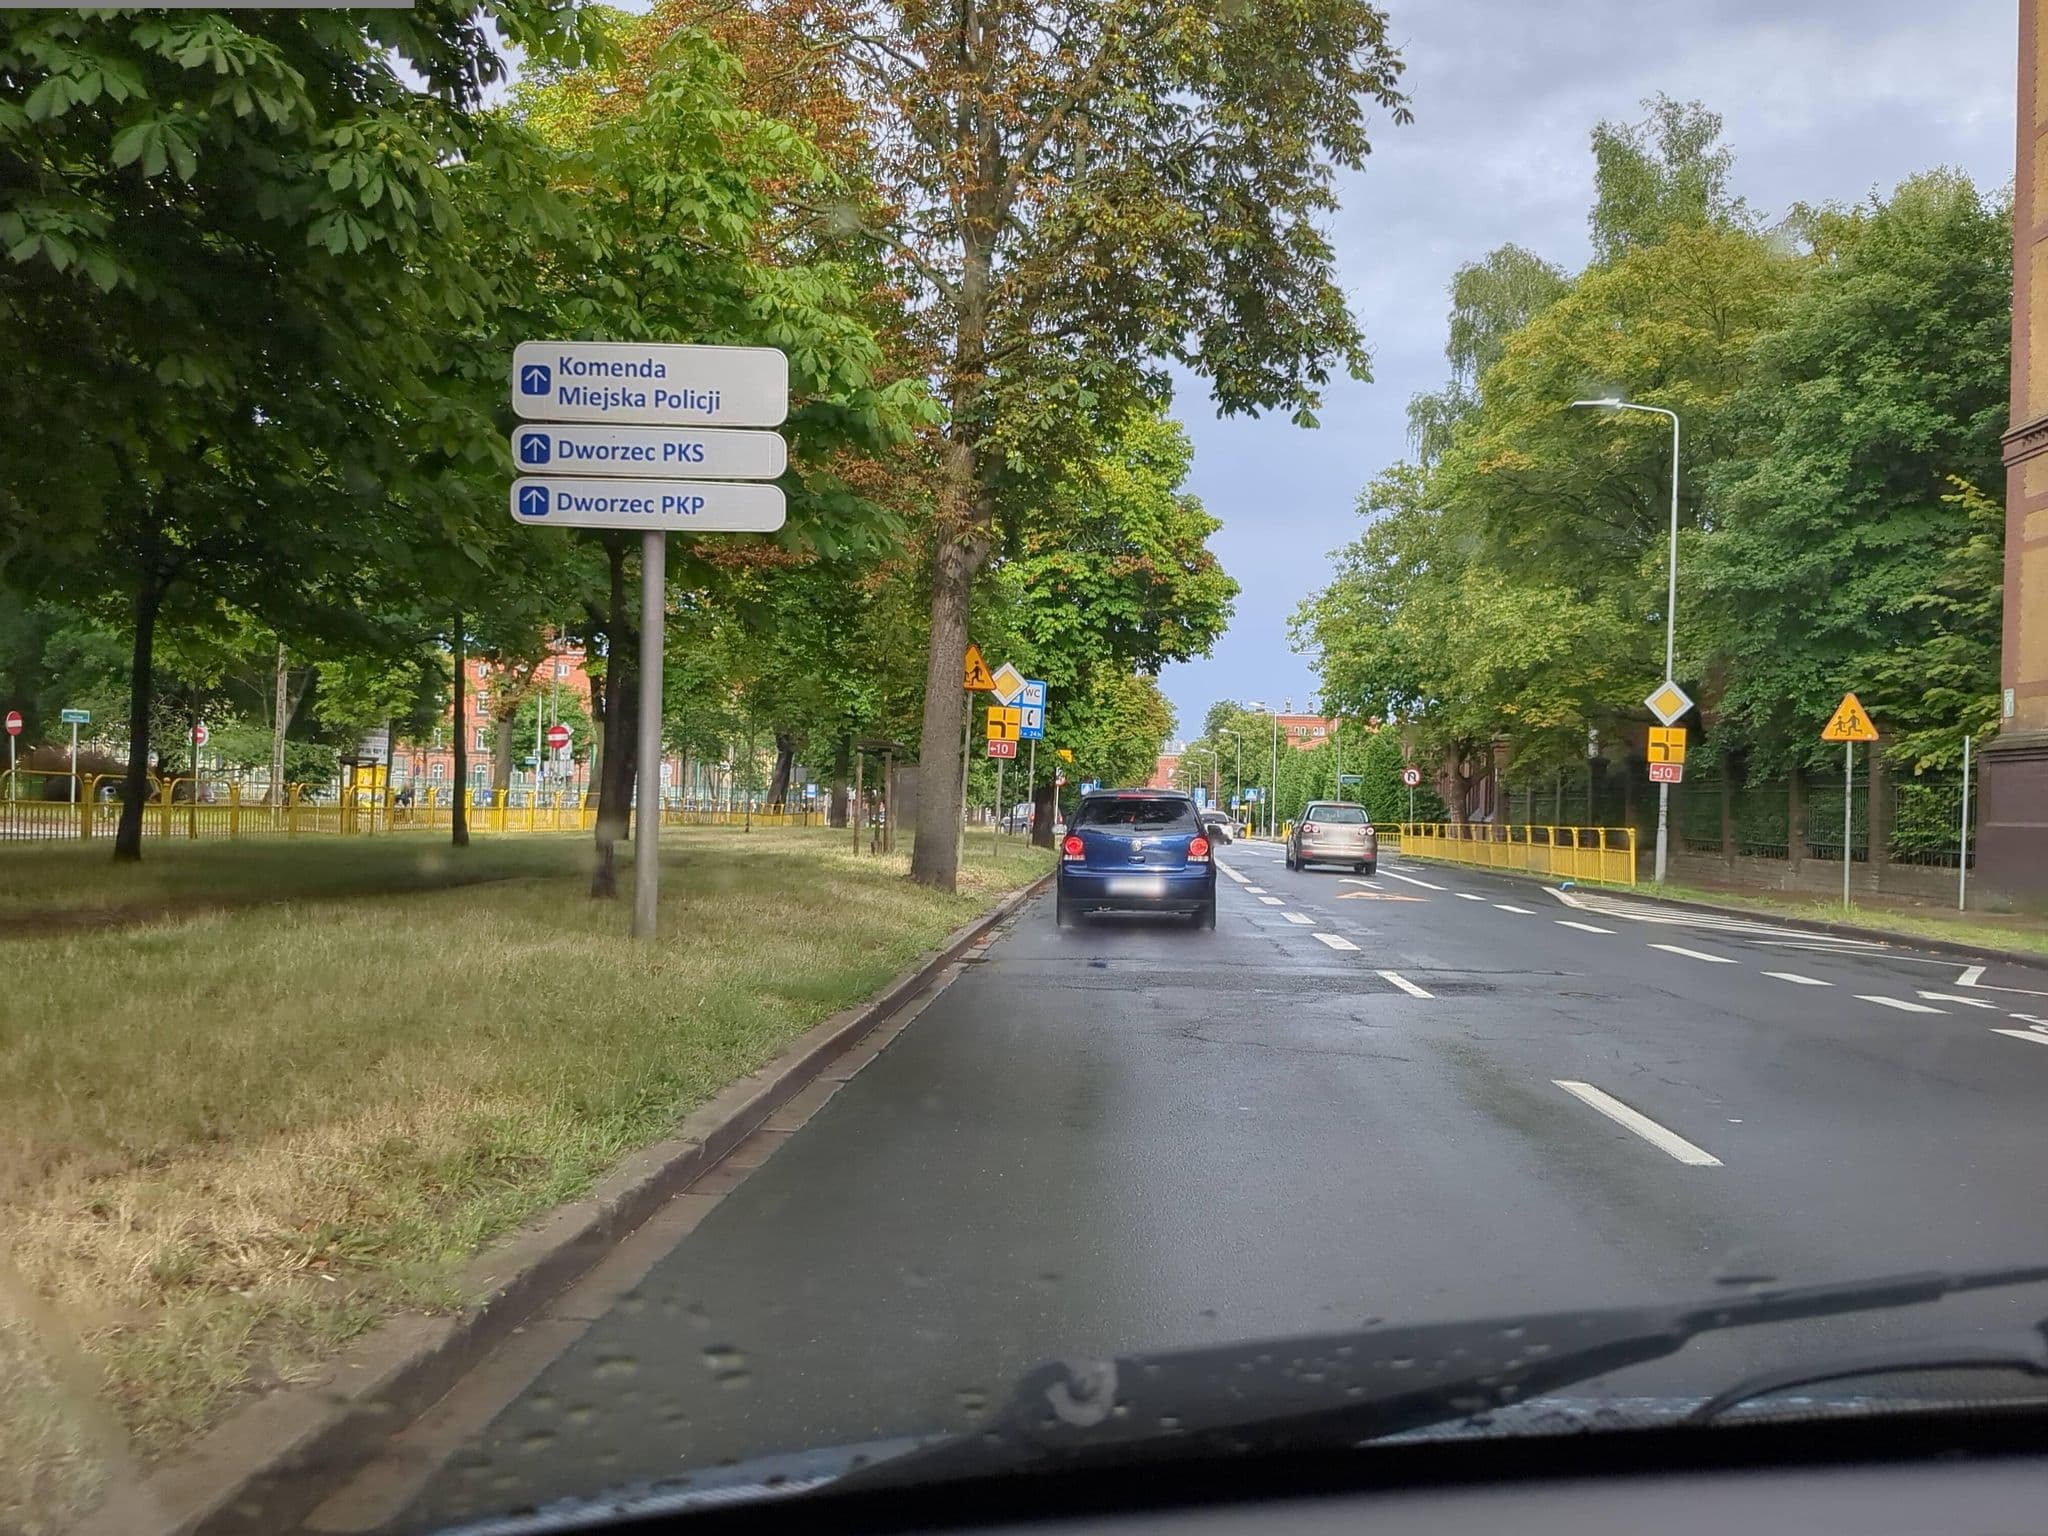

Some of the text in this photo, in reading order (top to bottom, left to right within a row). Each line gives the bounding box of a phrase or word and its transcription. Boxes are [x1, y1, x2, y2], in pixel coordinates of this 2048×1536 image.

[559, 356, 666, 379] Komenda
[558, 386, 721, 414] Miejska Policji
[558, 440, 705, 462] Dworzec PKS
[557, 492, 705, 515] Dworzec PKP
[1025, 688, 1041, 698] WC
[997, 744, 1009, 754] 10
[1659, 768, 1673, 779] 10
